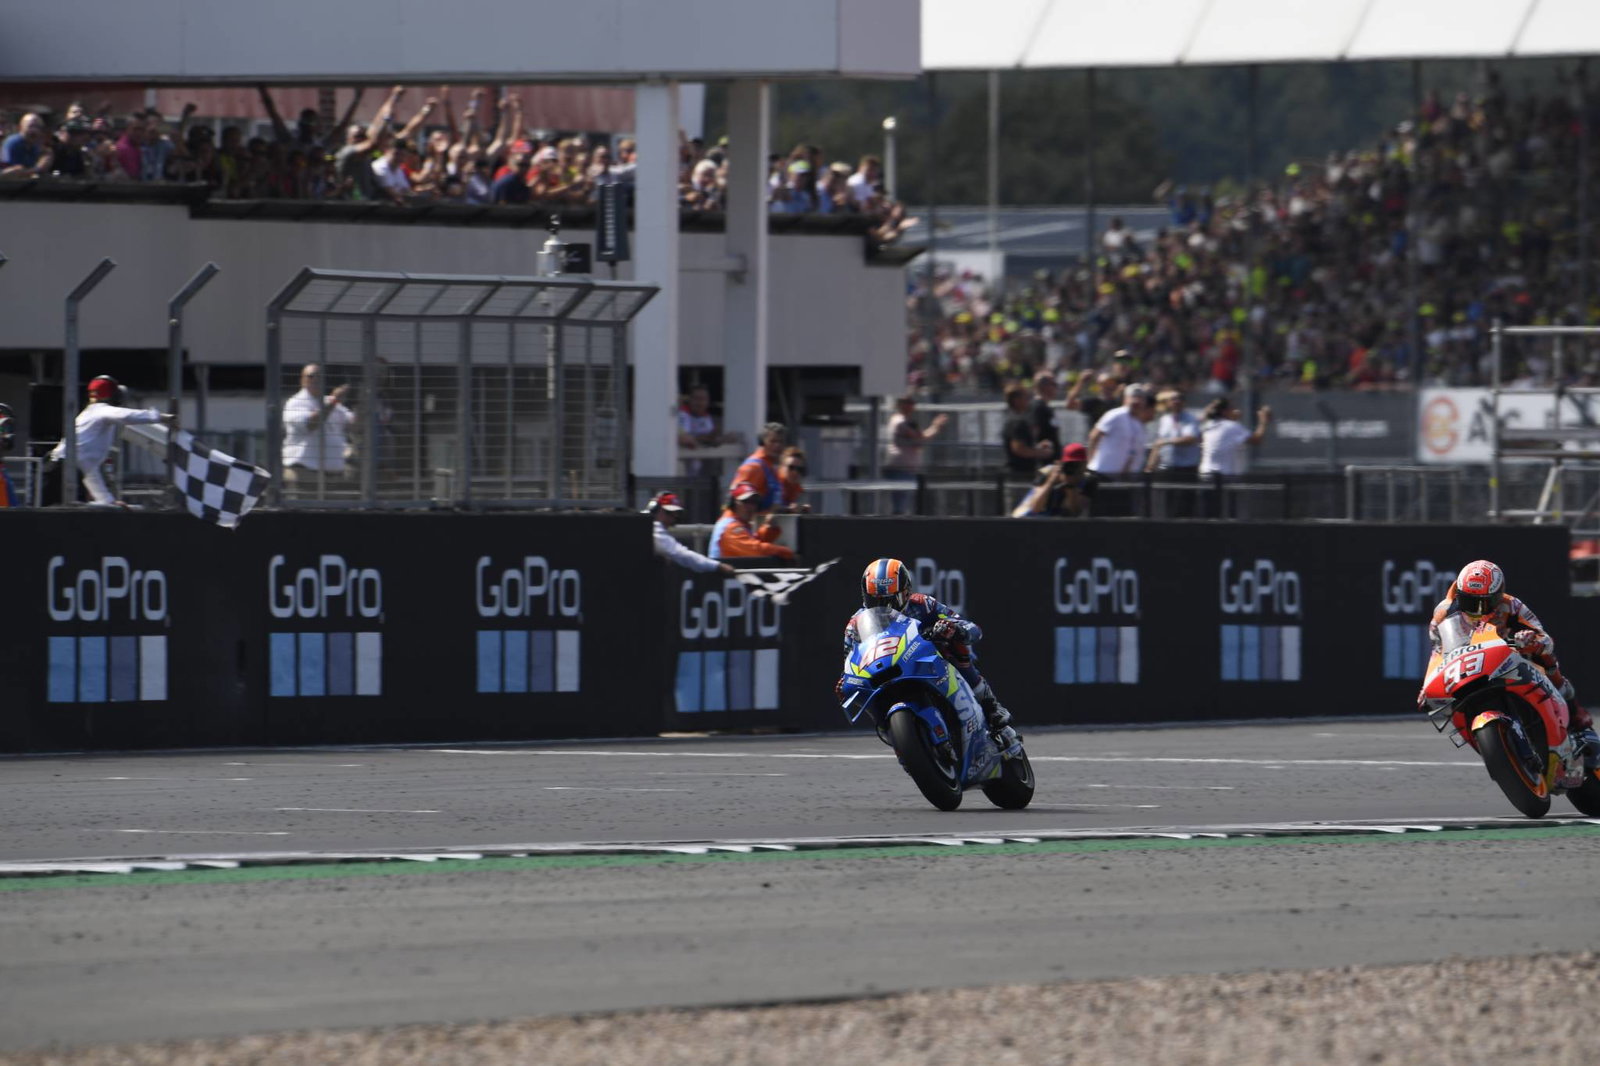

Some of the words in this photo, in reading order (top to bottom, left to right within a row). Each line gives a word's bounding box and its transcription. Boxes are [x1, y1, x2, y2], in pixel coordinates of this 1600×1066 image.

[48, 556, 167, 621] GoPro
[269, 554, 382, 618] GoPro
[476, 555, 580, 617] GoPro
[909, 557, 965, 613] Pro
[1055, 558, 1138, 614] GoPro
[1221, 559, 1299, 614] GoPro
[858, 635, 901, 672] 42
[1443, 652, 1485, 694] 93
